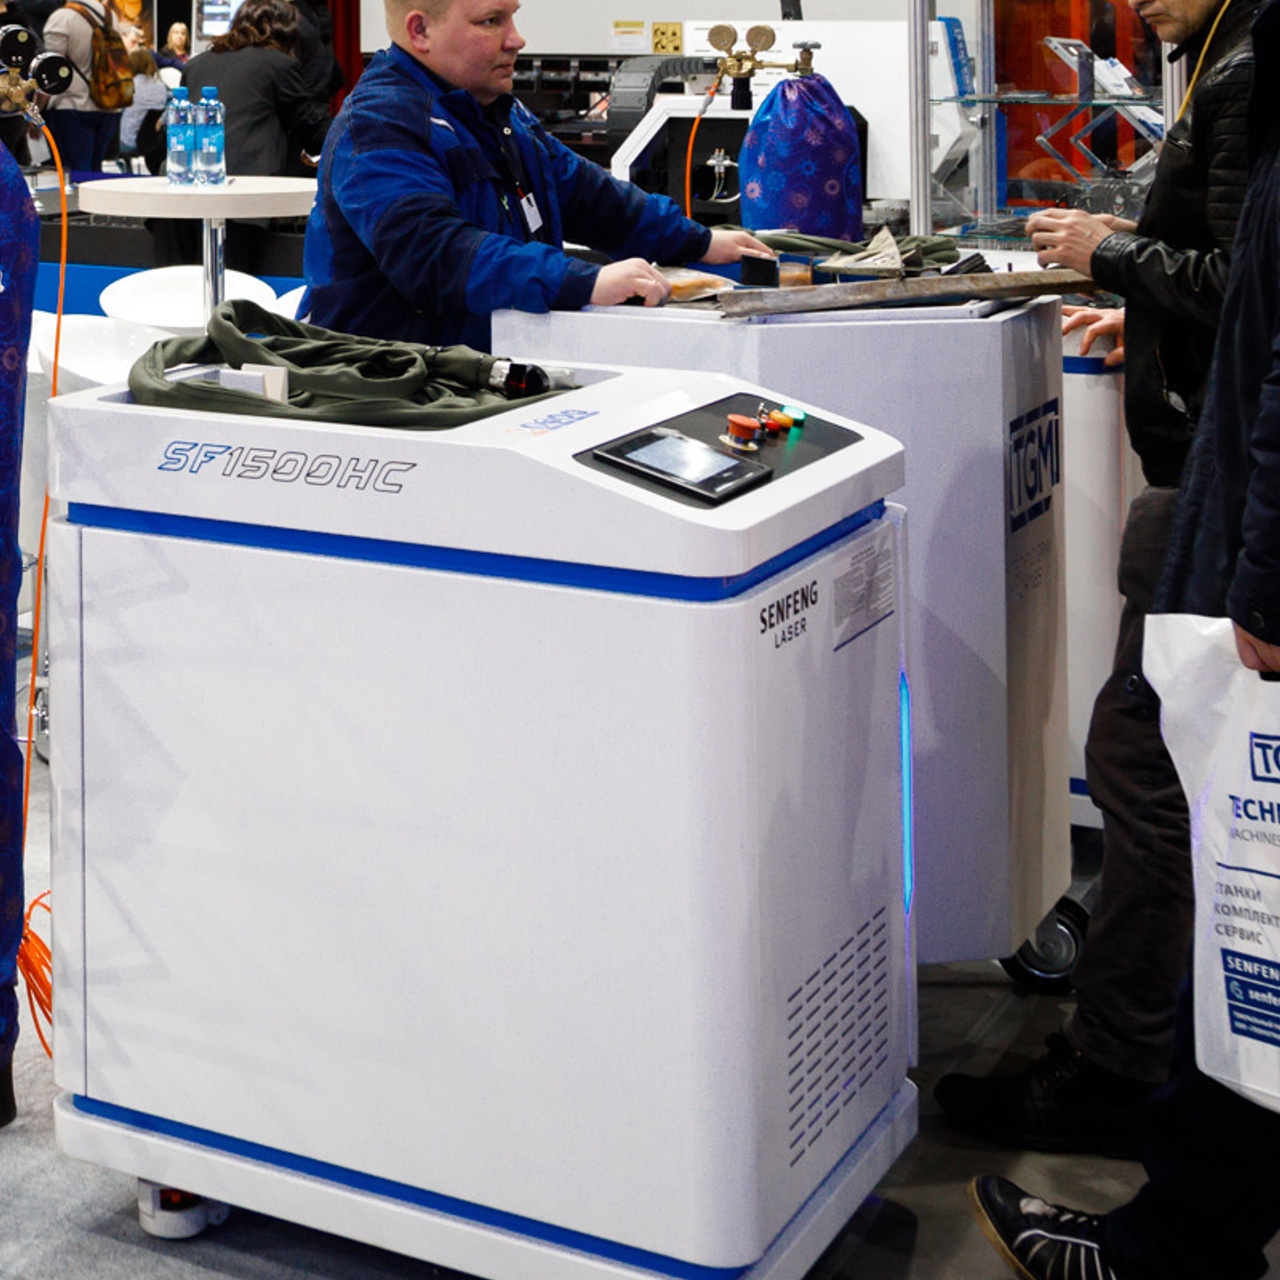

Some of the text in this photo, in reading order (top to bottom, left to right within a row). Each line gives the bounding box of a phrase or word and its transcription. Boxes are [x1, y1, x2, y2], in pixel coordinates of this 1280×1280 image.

[157, 440, 418, 494] SF1500HC
[759, 580, 818, 634] SENFENG
[774, 617, 808, 649] LASER
[1214, 923, 1263, 945] СЕРВИС
